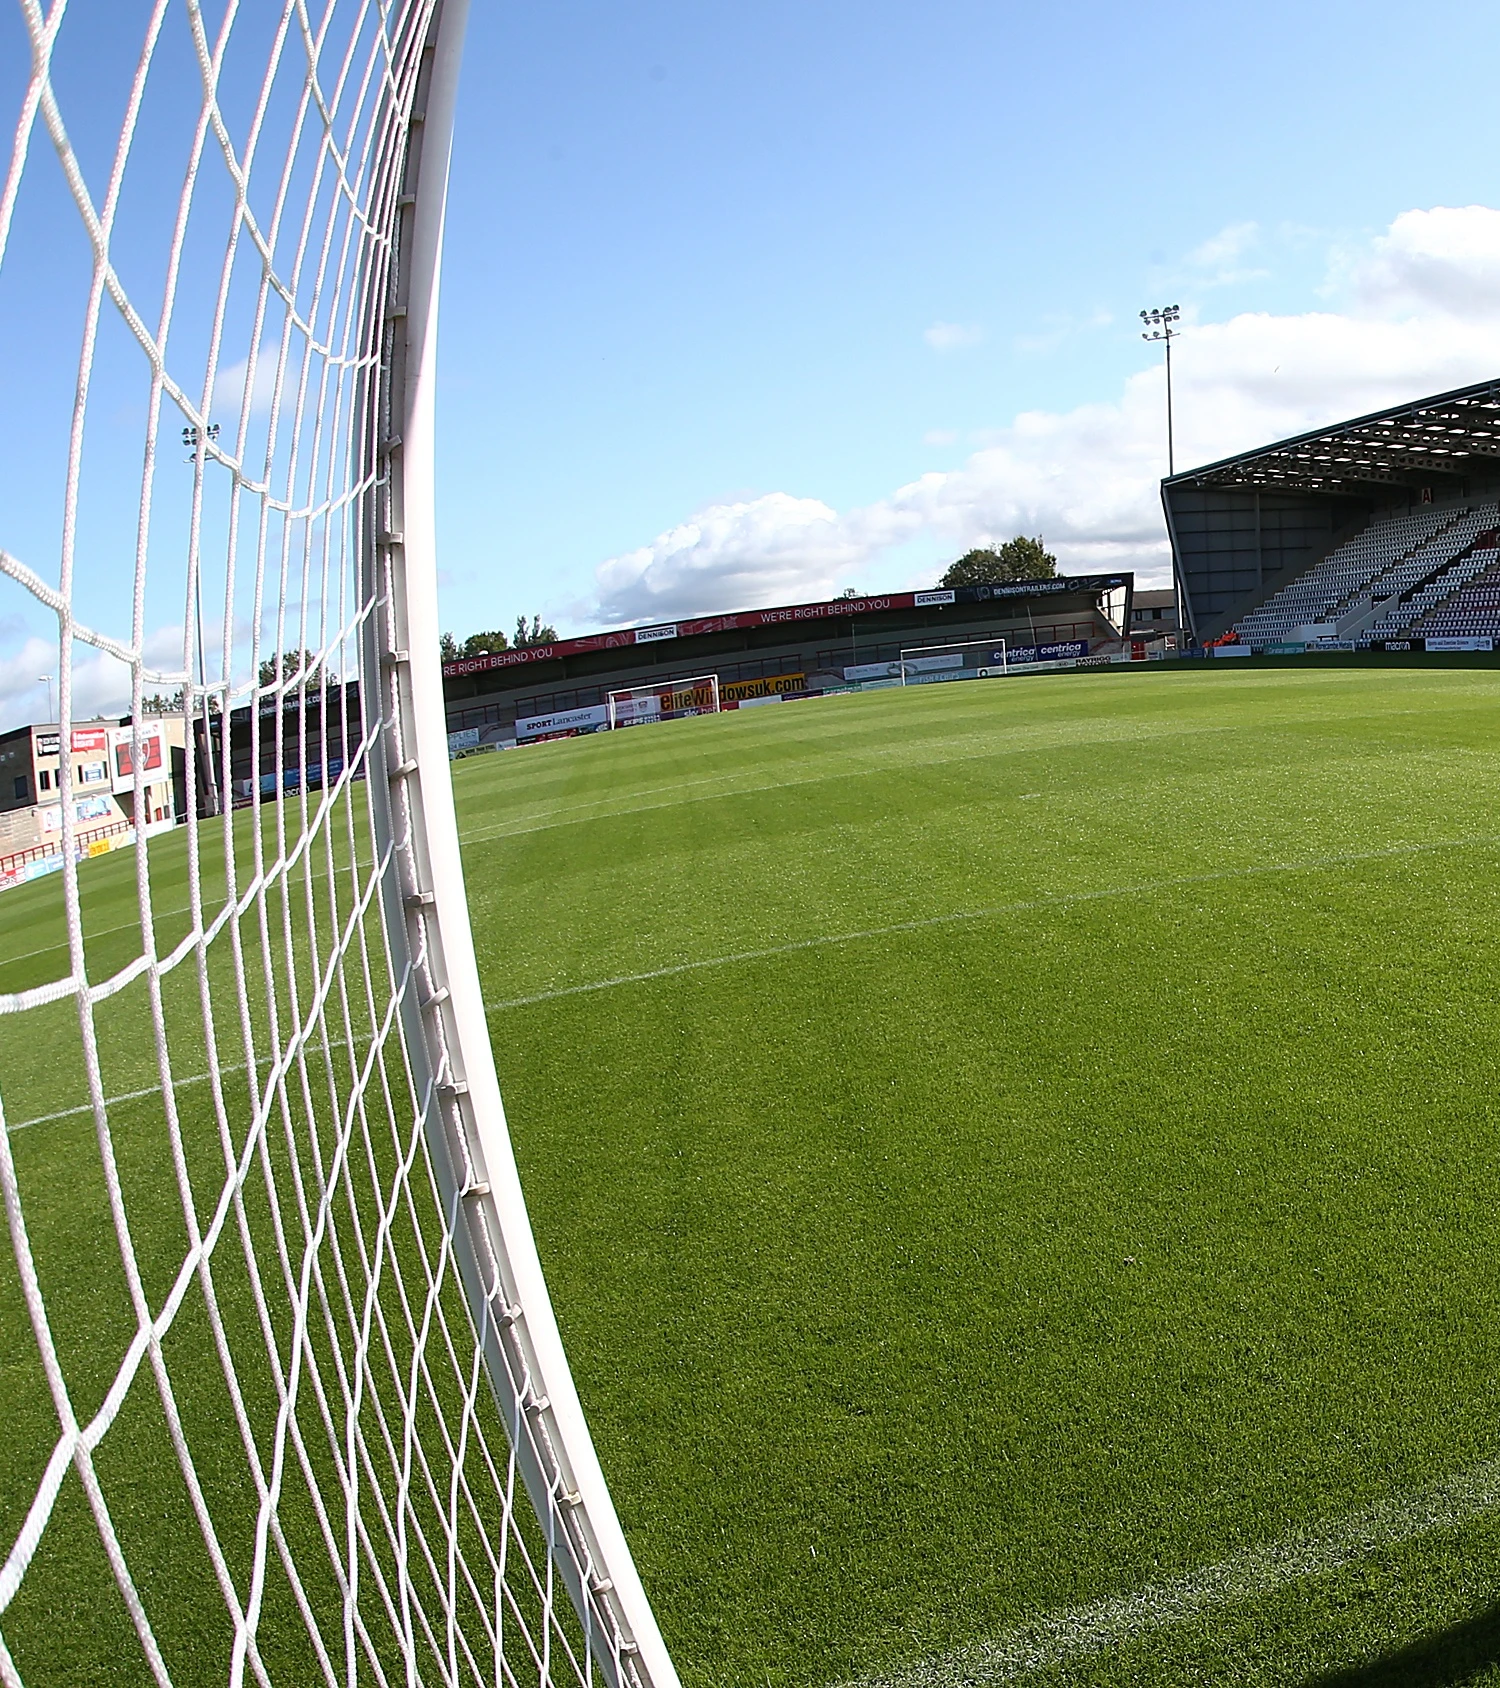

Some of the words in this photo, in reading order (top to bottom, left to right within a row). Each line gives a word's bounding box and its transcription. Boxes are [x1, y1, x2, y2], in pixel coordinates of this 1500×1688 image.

[917, 595, 952, 604] DENNISON
[760, 610, 792, 623] WE'RE
[794, 606, 824, 619] RIGHT
[828, 602, 866, 615] BEHIND
[868, 599, 890, 610] YOU
[638, 630, 674, 641] DENNISON
[1041, 643, 1081, 655] centrica
[1385, 641, 1410, 651] macron
[1057, 649, 1081, 658] energy
[458, 659, 488, 673] RIGHT
[490, 652, 528, 667] BEHIND
[530, 648, 553, 659] YOU
[684, 709, 698, 717] sky
[701, 706, 717, 715] bet
[449, 730, 477, 740] PPLIES
